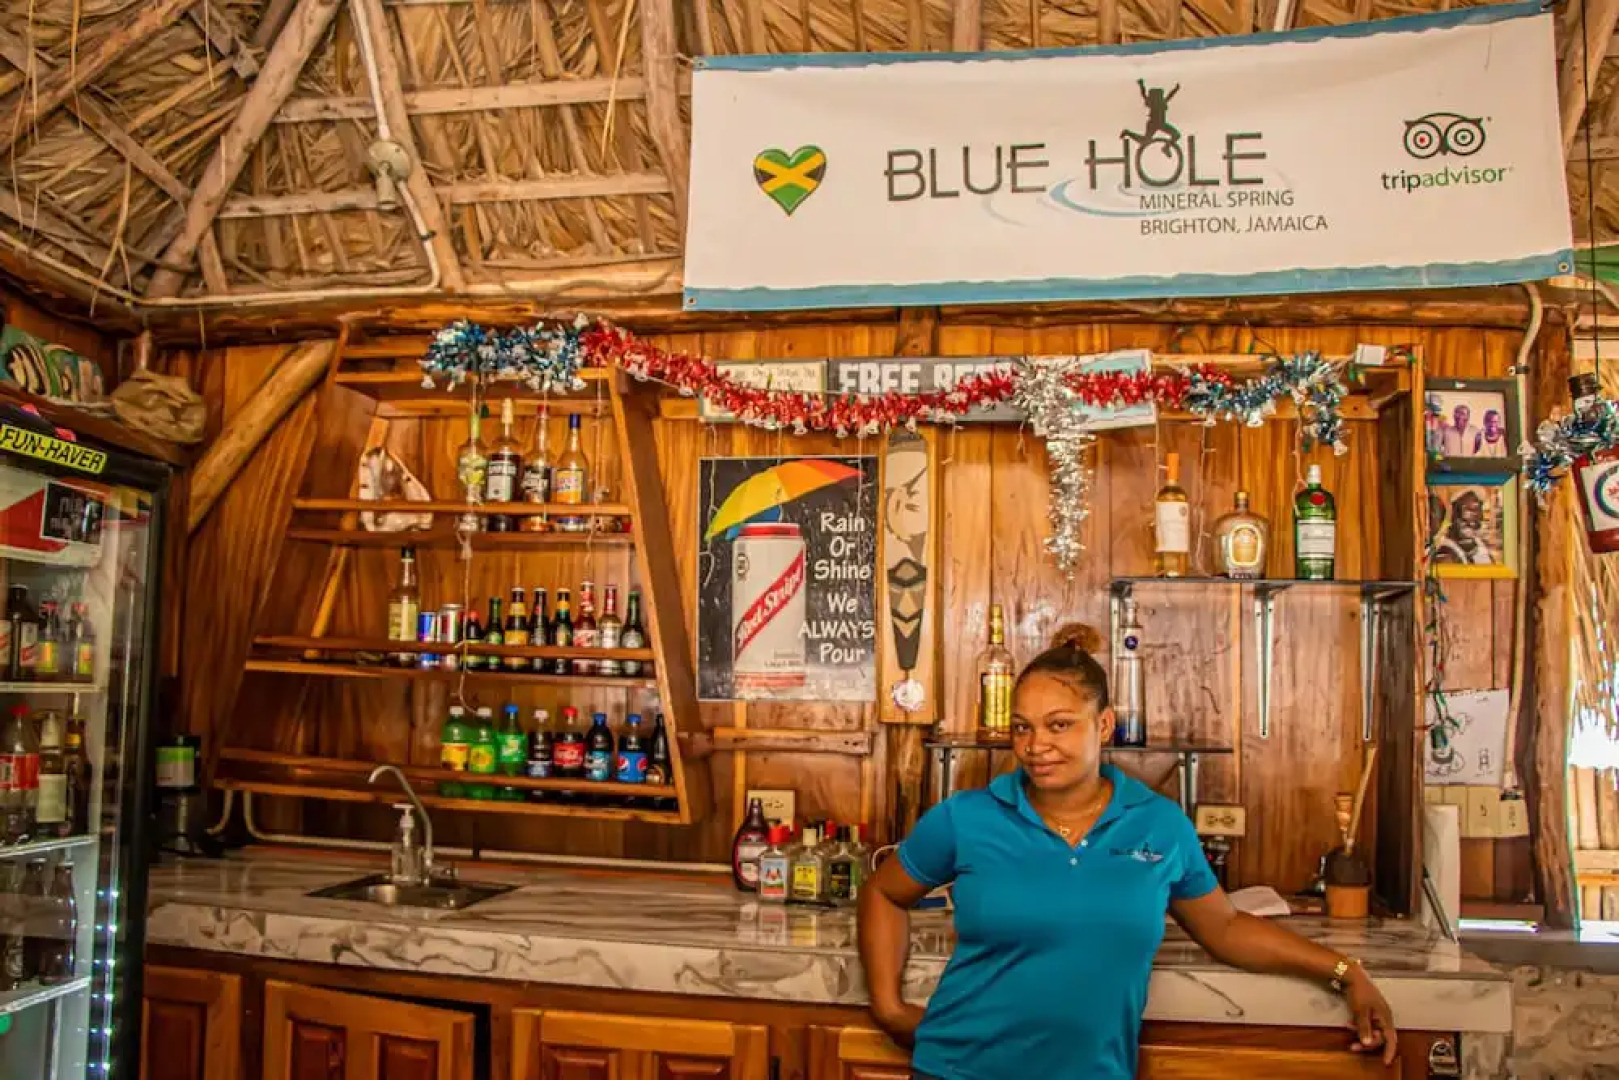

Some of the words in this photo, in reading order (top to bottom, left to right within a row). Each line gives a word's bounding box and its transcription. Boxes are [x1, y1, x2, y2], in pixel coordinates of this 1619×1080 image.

[884, 143, 1049, 201] BLUE
[1085, 132, 1266, 189] HOLE
[1381, 165, 1506, 193] tripadvisor
[1139, 193, 1221, 209] MINERAL
[1226, 190, 1294, 208] SPRING
[1140, 216, 1241, 236] BRIGHTON,
[1245, 215, 1328, 233] JAMAICA
[839, 362, 921, 393] FREE
[2, 428, 104, 471] FUN-HAVER
[820, 512, 865, 533] Rain
[829, 535, 856, 557] Or
[813, 559, 871, 580] Shine
[826, 592, 858, 614] We
[797, 620, 875, 639] ALWAYS
[820, 642, 865, 664] Pour
